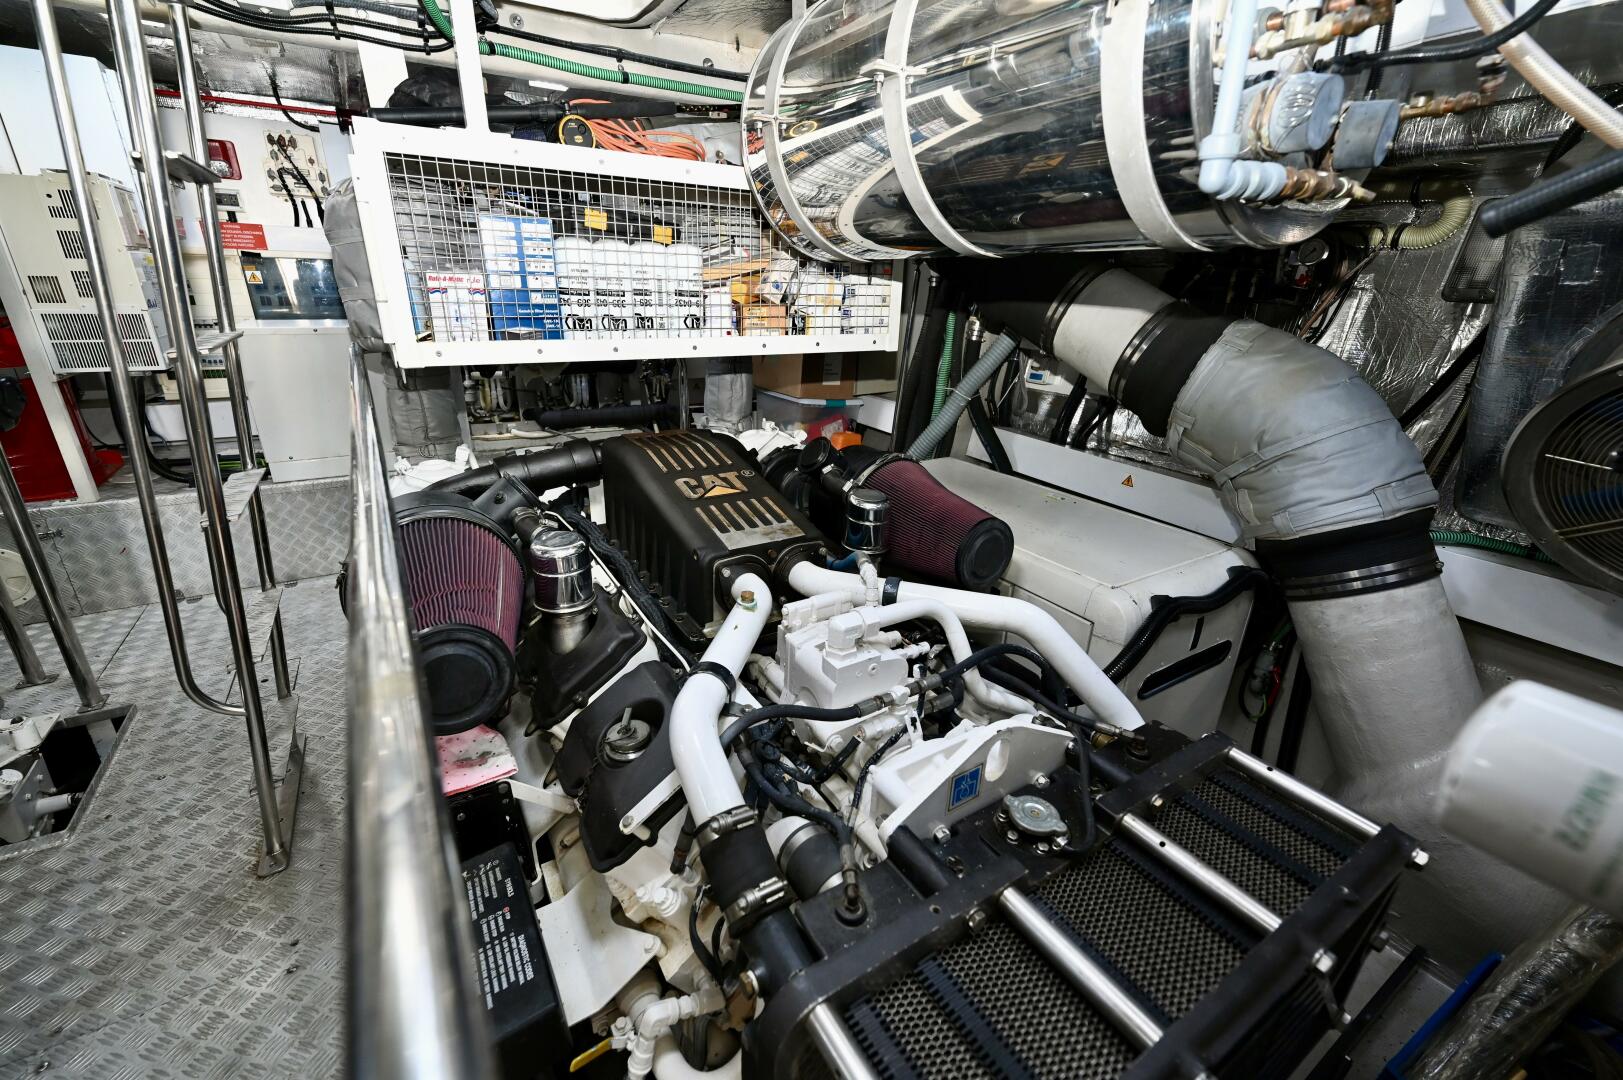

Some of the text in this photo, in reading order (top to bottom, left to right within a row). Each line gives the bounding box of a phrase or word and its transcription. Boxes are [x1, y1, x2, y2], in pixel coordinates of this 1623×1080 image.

[572, 317, 593, 332] CAT
[635, 316, 654, 330] CAT
[674, 471, 748, 499] CAT
